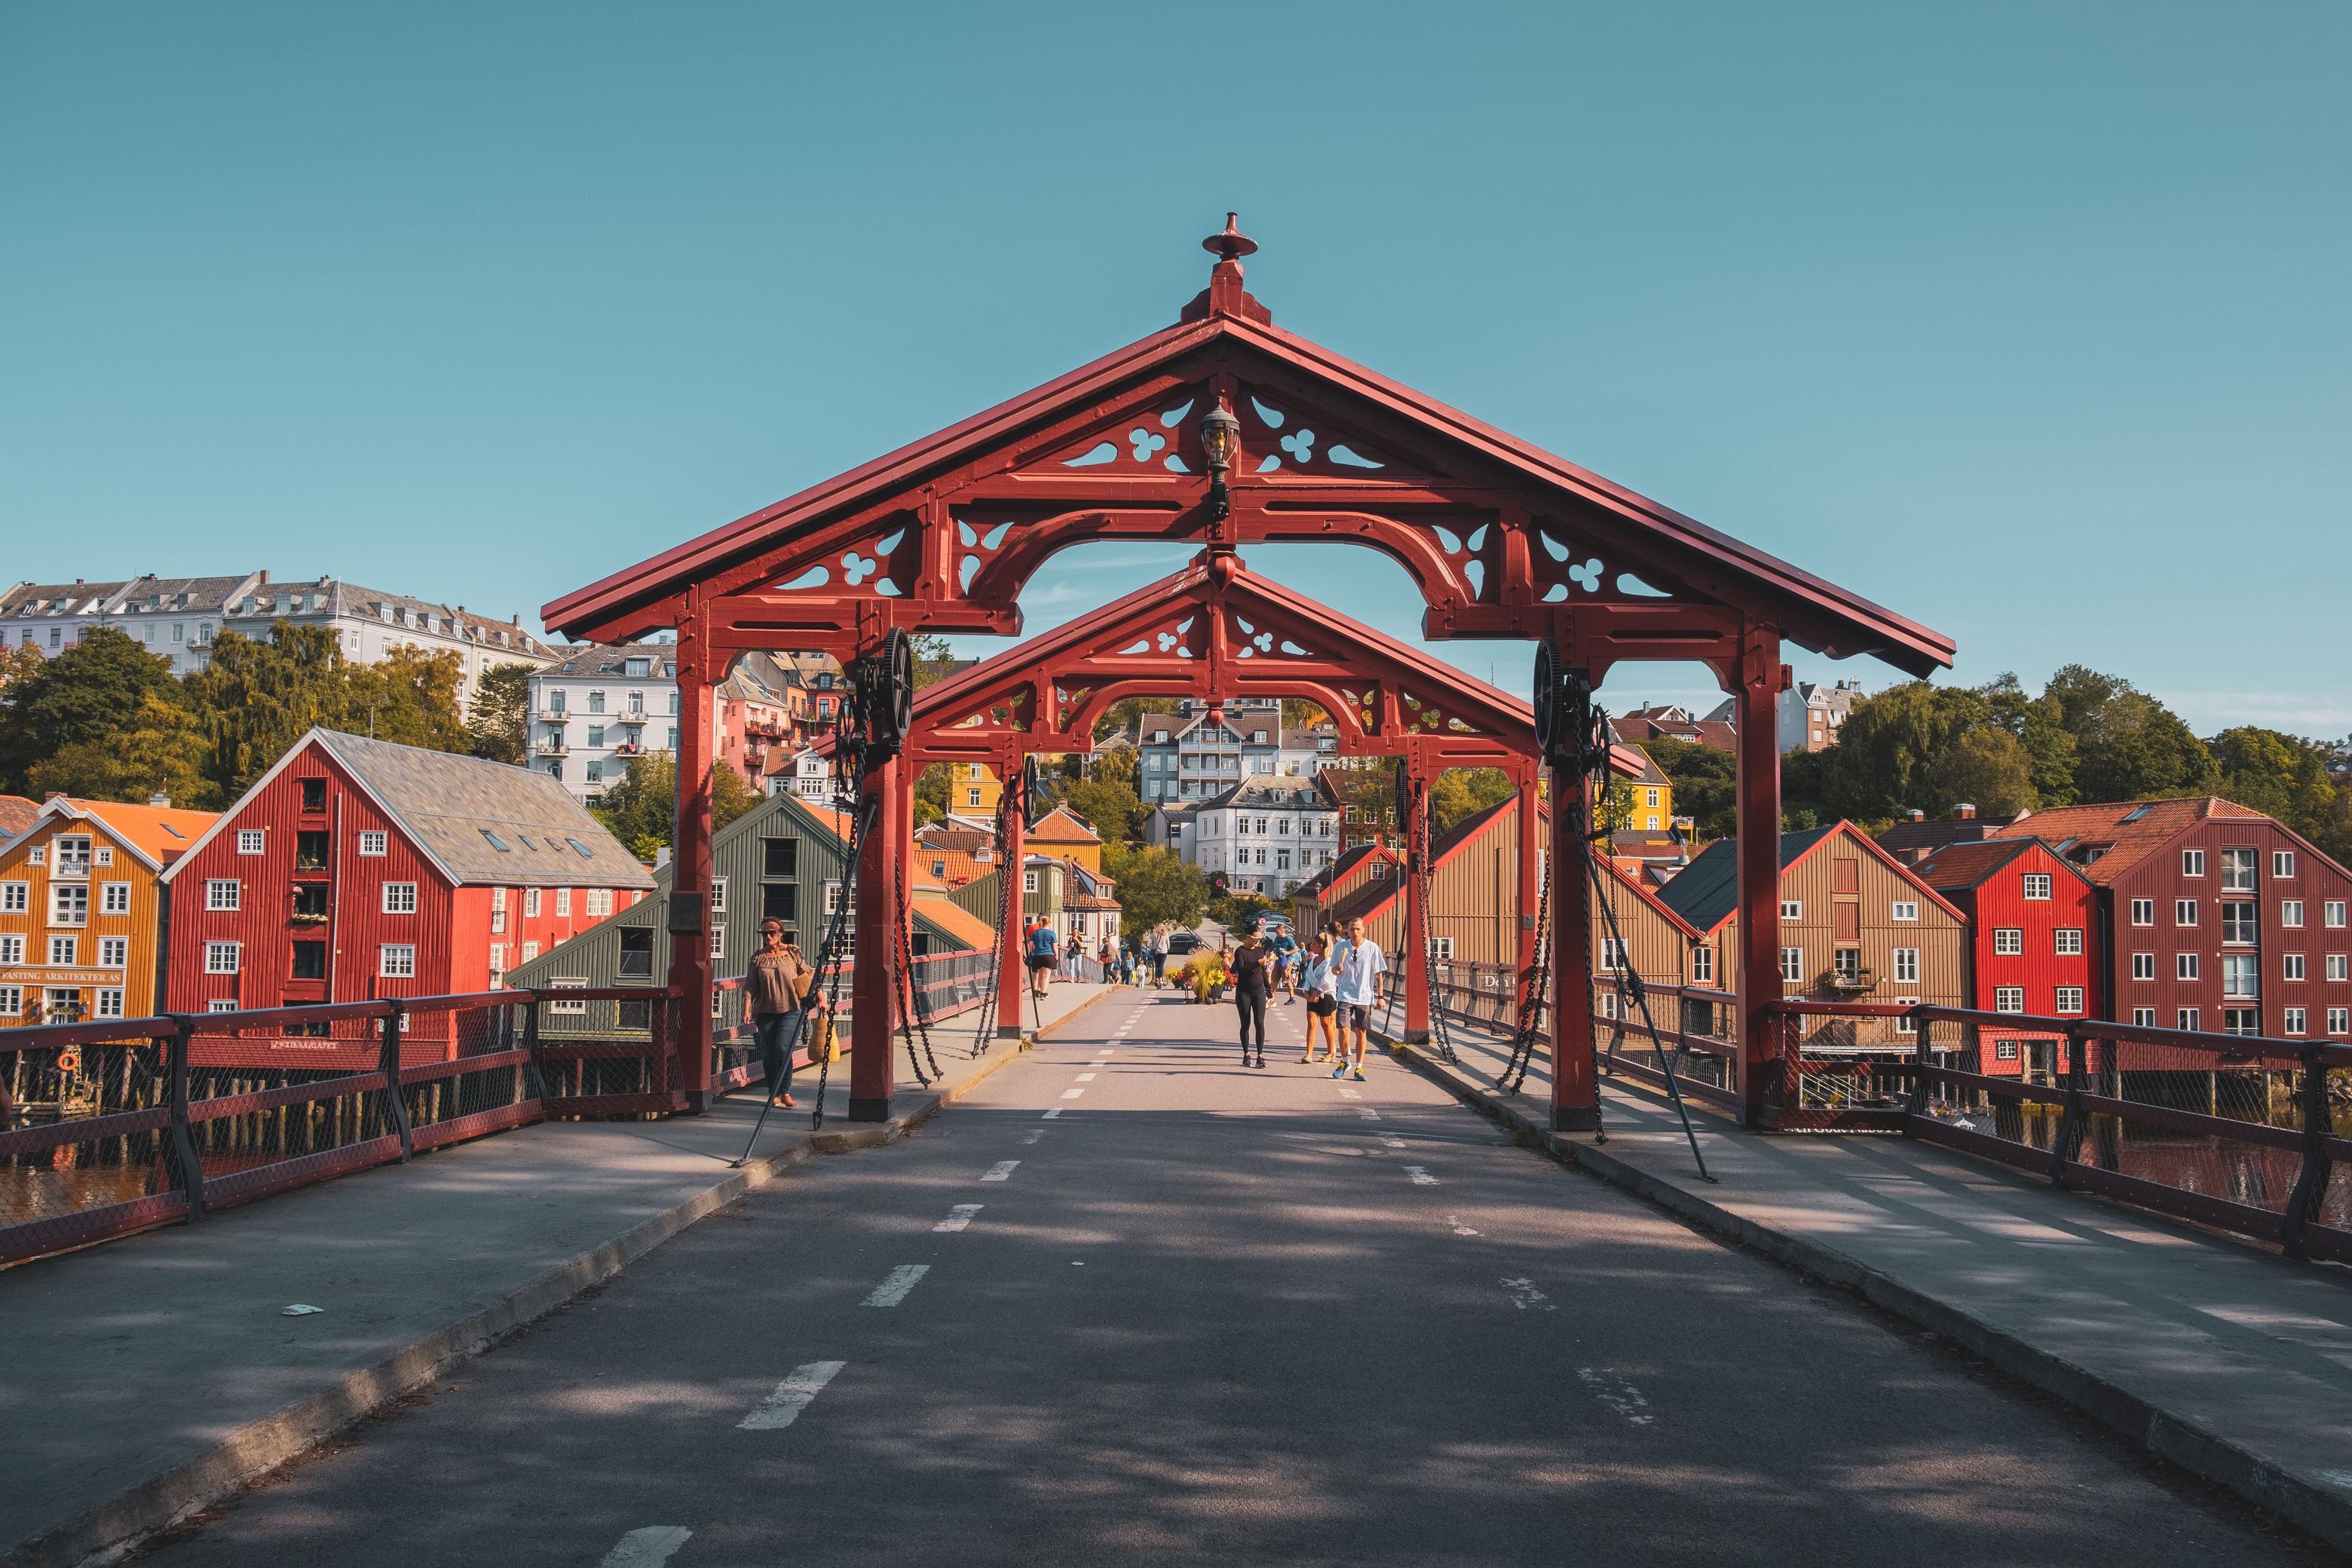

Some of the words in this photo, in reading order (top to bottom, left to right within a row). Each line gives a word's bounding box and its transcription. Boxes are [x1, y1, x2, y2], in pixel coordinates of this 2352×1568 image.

[2, 972, 41, 980] FASTING
[44, 972, 106, 982] ARKITEKTER
[109, 974, 121, 982] AS
